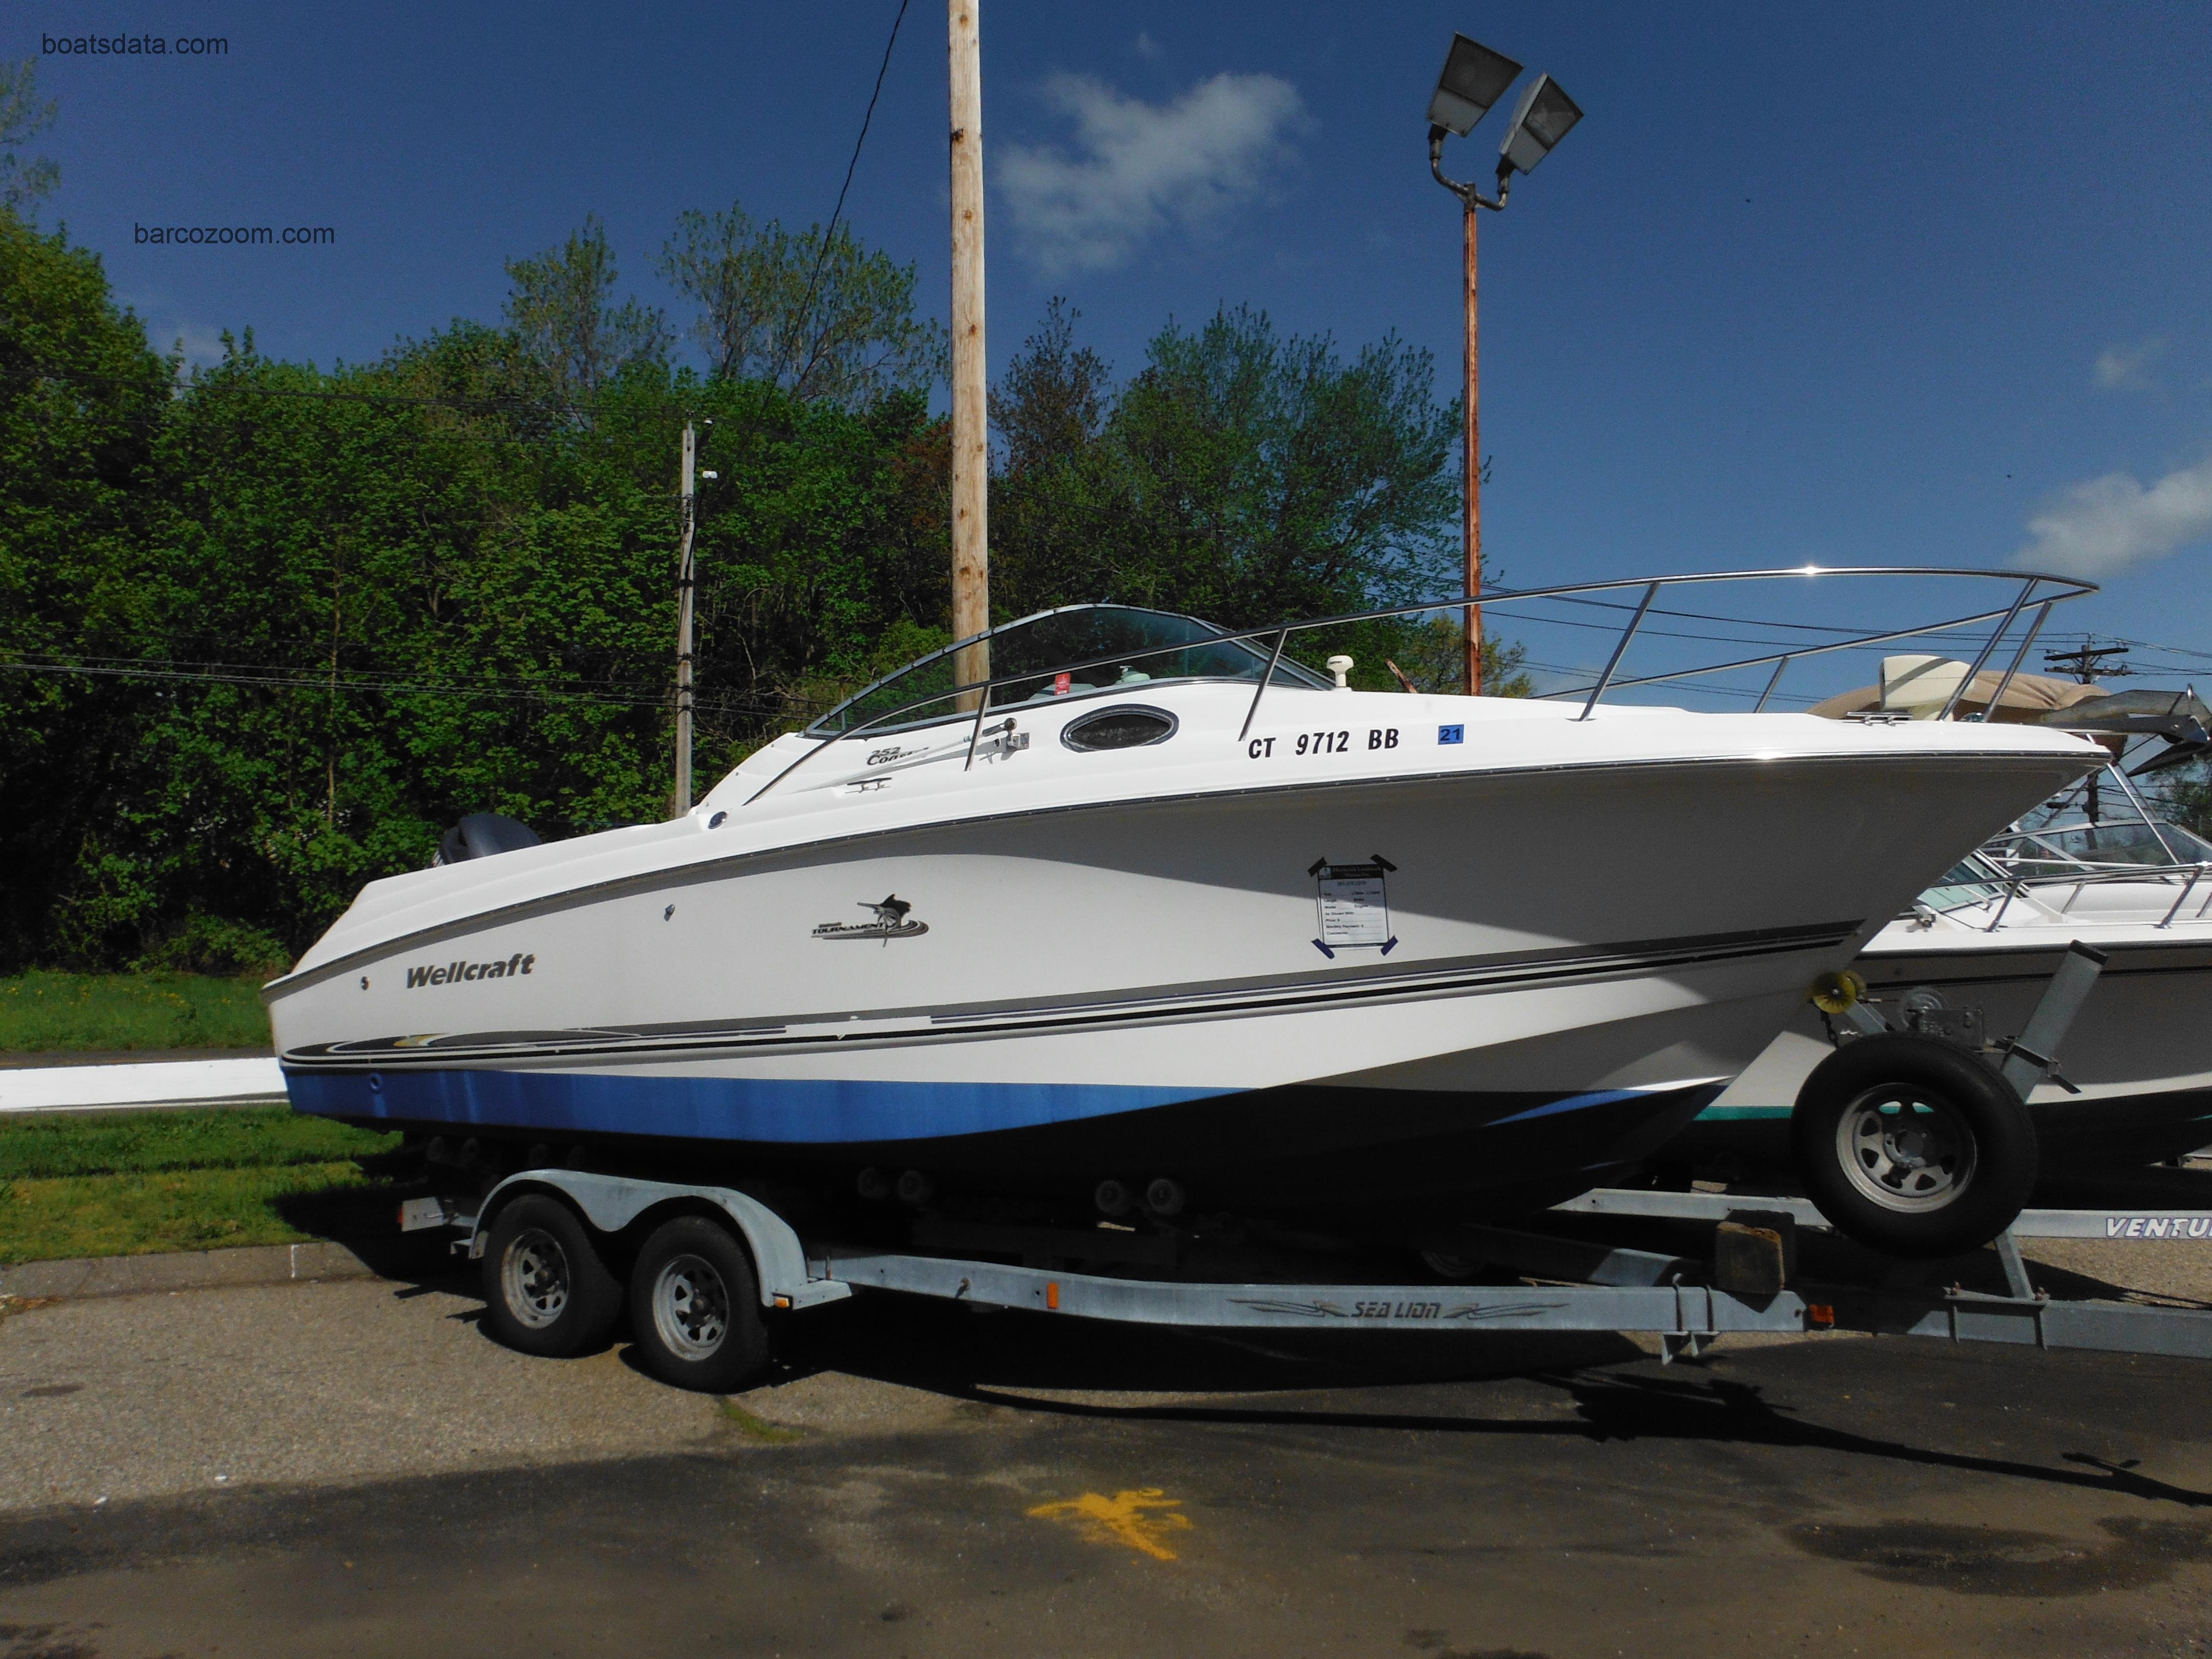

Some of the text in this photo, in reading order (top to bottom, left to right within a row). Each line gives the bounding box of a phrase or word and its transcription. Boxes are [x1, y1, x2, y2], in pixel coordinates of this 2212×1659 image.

[1248, 728, 1399, 759] CT 9712 BB
[1440, 728, 1460, 741] 21
[870, 746, 901, 756] 252
[407, 953, 535, 989] Wellcraft
[2106, 1217, 2212, 1238] VENTU
[1352, 1301, 1441, 1319] SEA LION
